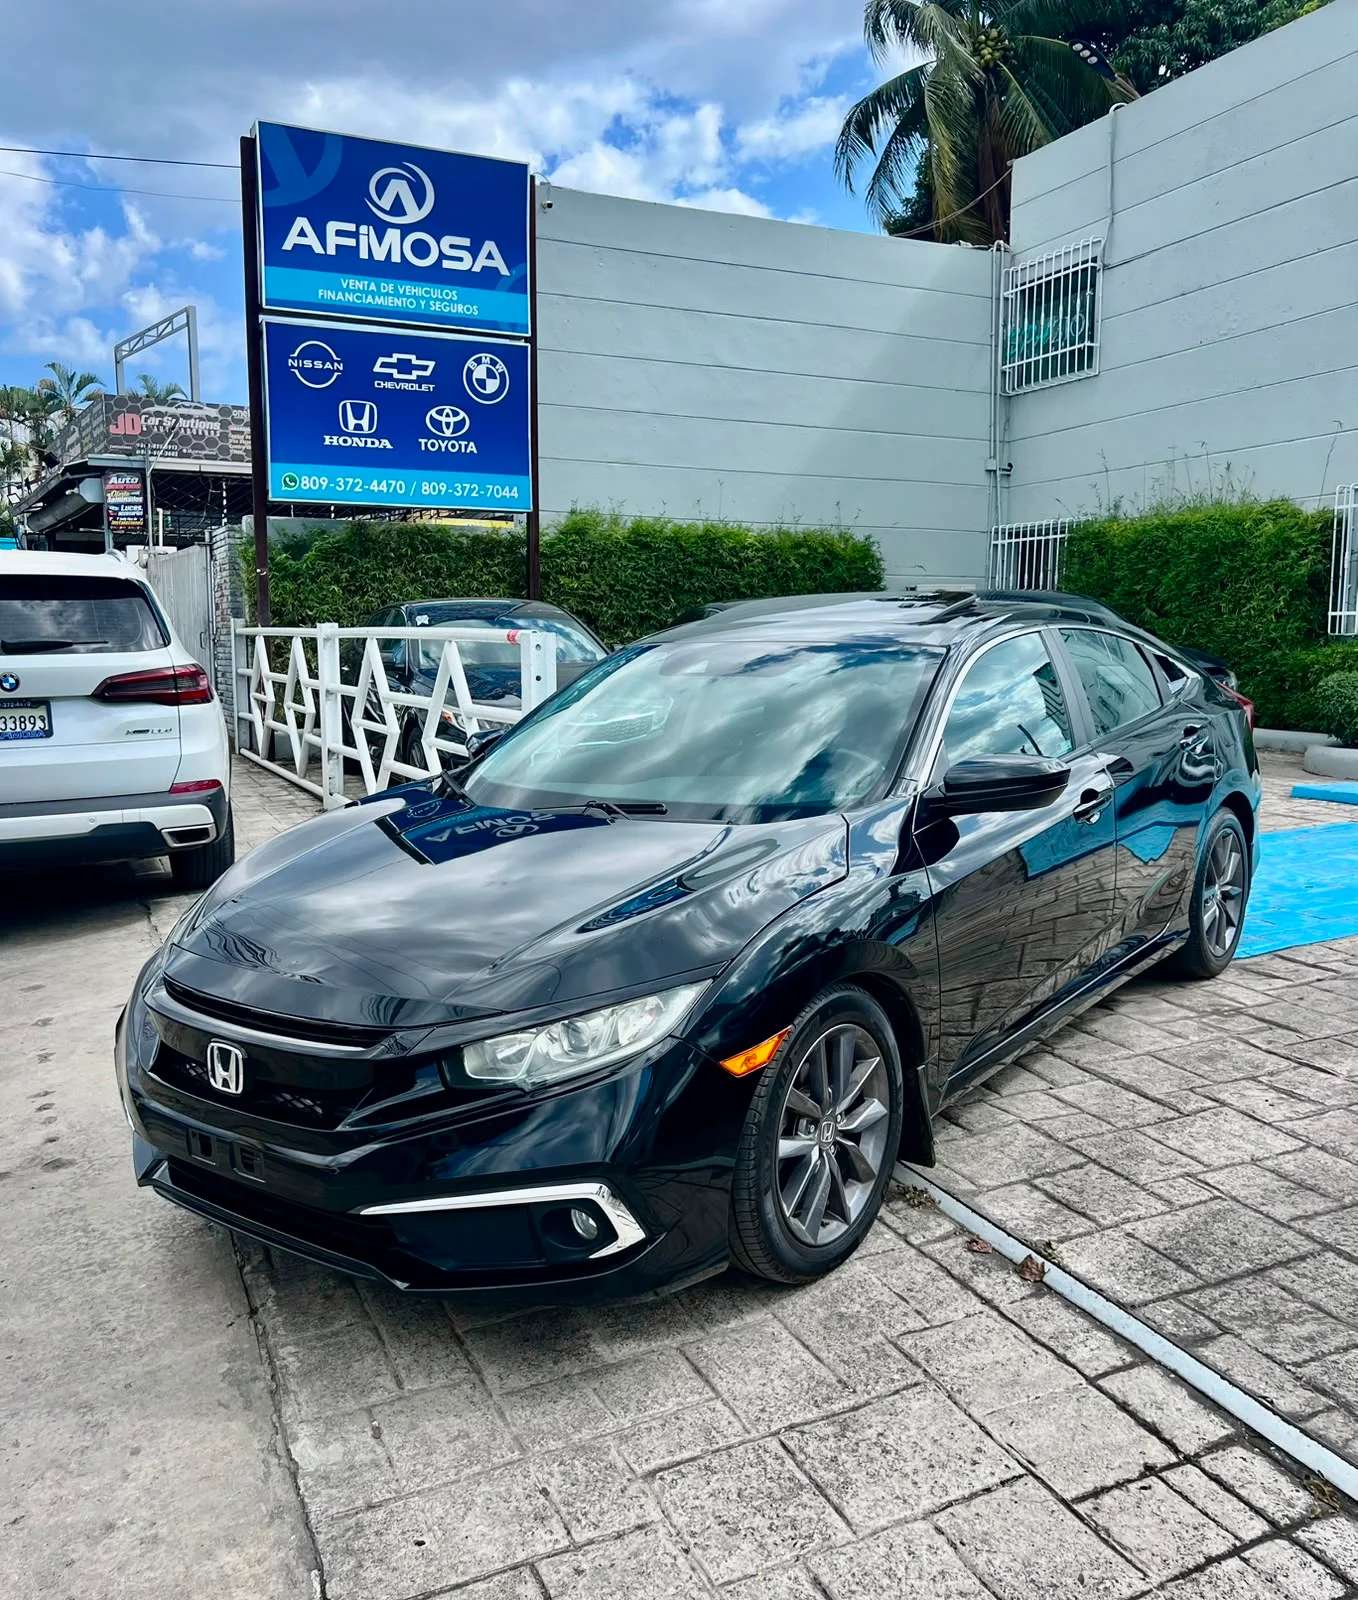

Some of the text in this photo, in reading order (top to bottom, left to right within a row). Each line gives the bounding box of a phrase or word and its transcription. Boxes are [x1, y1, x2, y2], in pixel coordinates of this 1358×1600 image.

[340, 278, 458, 301] VENTA DE VEHICULOS
[318, 289, 479, 316] FINANCIAMIENTO Y SEGUROS
[288, 358, 343, 371] NISSAN
[374, 380, 436, 392] CHEVROLET
[109, 412, 142, 435] JD
[323, 435, 394, 449] HONDA
[418, 438, 478, 454] TOYOTA
[301, 475, 406, 495] 809-372-4470
[421, 478, 519, 498] 809-372-7044
